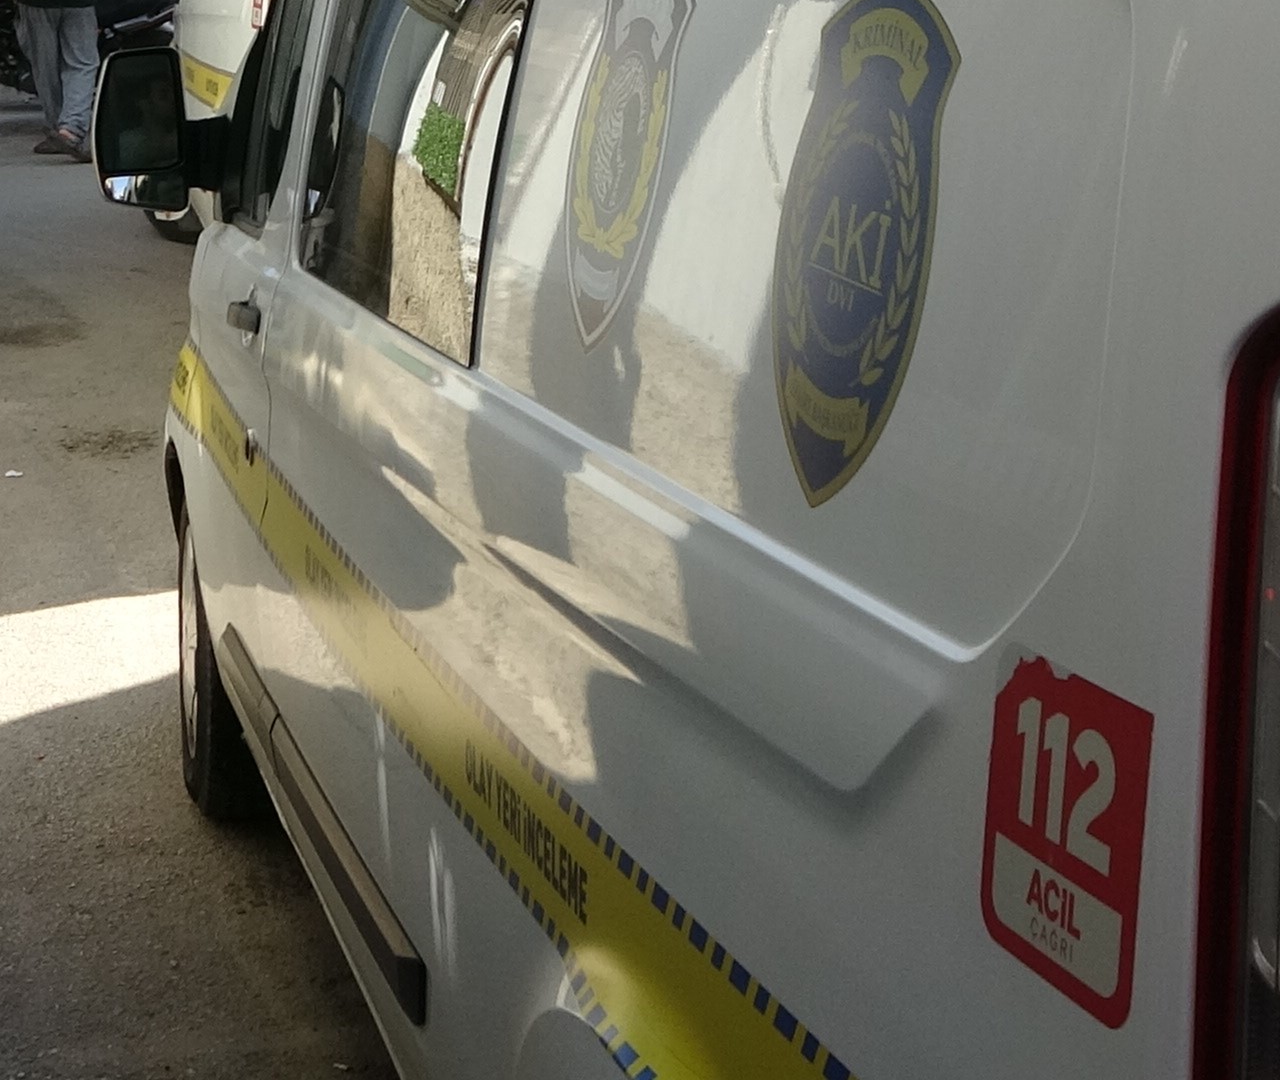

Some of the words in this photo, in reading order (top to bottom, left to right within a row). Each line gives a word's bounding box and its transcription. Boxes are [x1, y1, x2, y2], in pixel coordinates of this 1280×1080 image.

[809, 195, 892, 290] AKİ
[465, 738, 494, 809] OLAY
[523, 800, 588, 925] İNCELEME
[1016, 695, 1117, 878] 112
